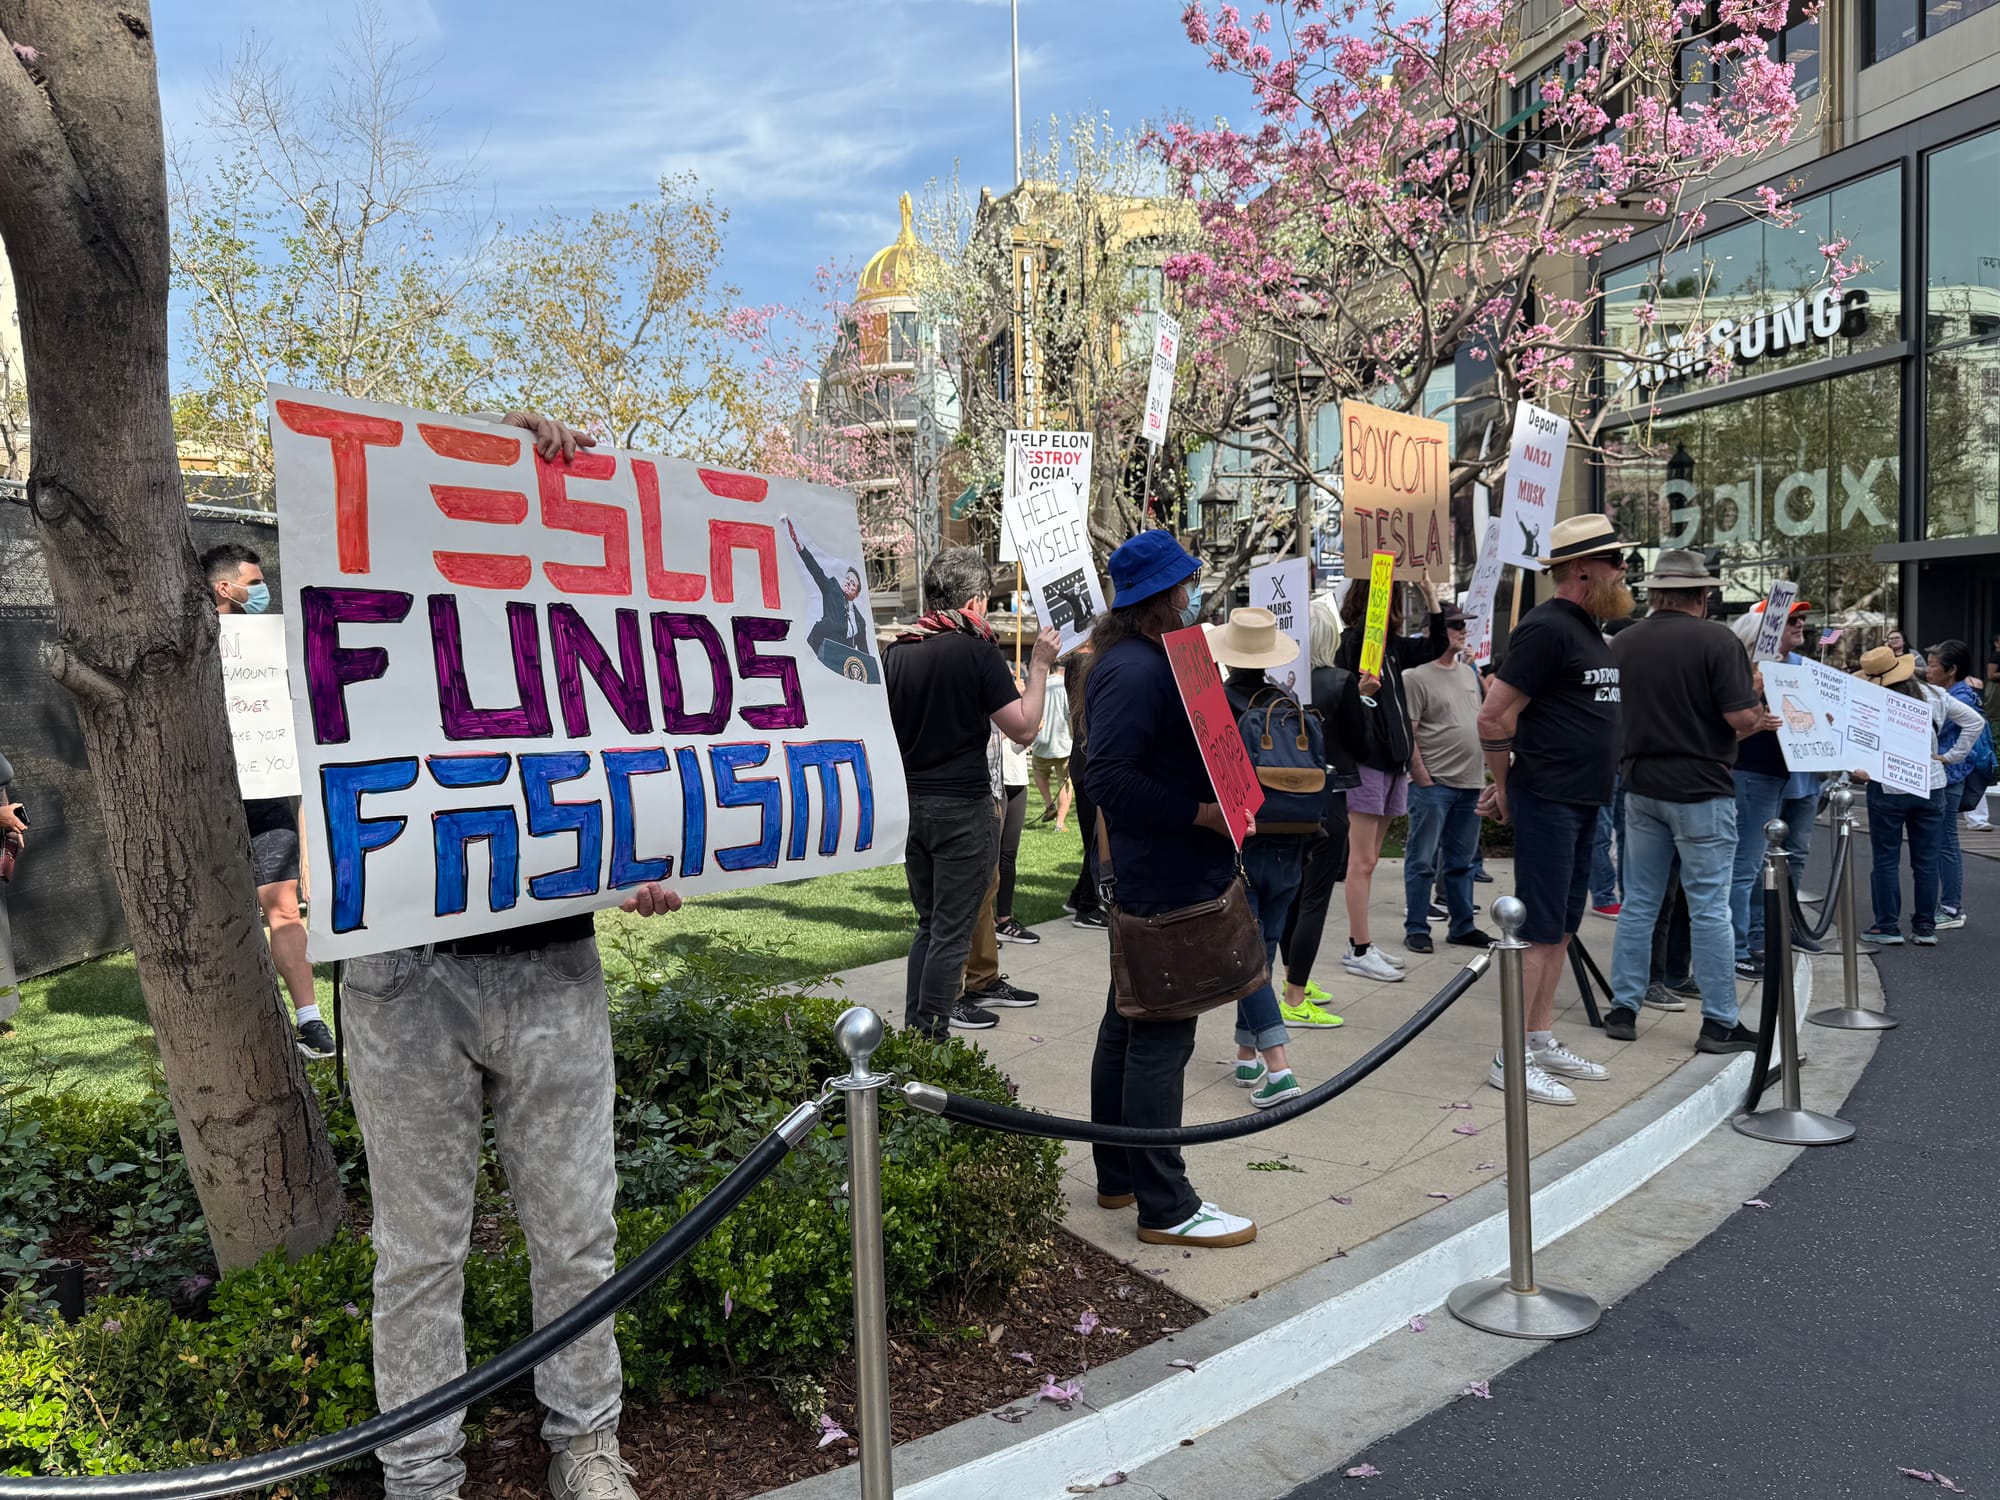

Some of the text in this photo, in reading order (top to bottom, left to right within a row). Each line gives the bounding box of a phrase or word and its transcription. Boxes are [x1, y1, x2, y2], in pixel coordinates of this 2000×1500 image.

[1616, 287, 1843, 392] SAMSUNG
[1528, 408, 1558, 436] Deport
[1009, 433, 1089, 448] HELP ELON
[1028, 450, 1082, 465] ESTROY
[1348, 416, 1443, 505] BOYCOTT
[1524, 444, 1552, 469] NAZI
[1028, 466, 1073, 480] OCIAL
[1517, 479, 1546, 508] MUSK
[275, 397, 782, 610] TESLA
[1018, 488, 1068, 532] HEIL
[1354, 506, 1443, 568] TESLA
[1018, 519, 1080, 572] MYSELF
[1271, 574, 1286, 600] X
[1267, 601, 1292, 615] MARKS
[1279, 616, 1294, 630] ROT
[299, 586, 808, 744] FUNDS
[1820, 671, 1844, 685] TRUMP
[1820, 680, 1841, 693] MUSK
[1820, 689, 1841, 701] NAZIS
[1899, 711, 1927, 726] FASCISM
[1908, 705, 1928, 716] COUP
[257, 728, 287, 744] YOUR
[1887, 756, 1915, 770] AMERICA
[1888, 763, 1923, 780] NOT RULED
[1905, 776, 1921, 788] KING
[319, 738, 875, 935] FASCISM
